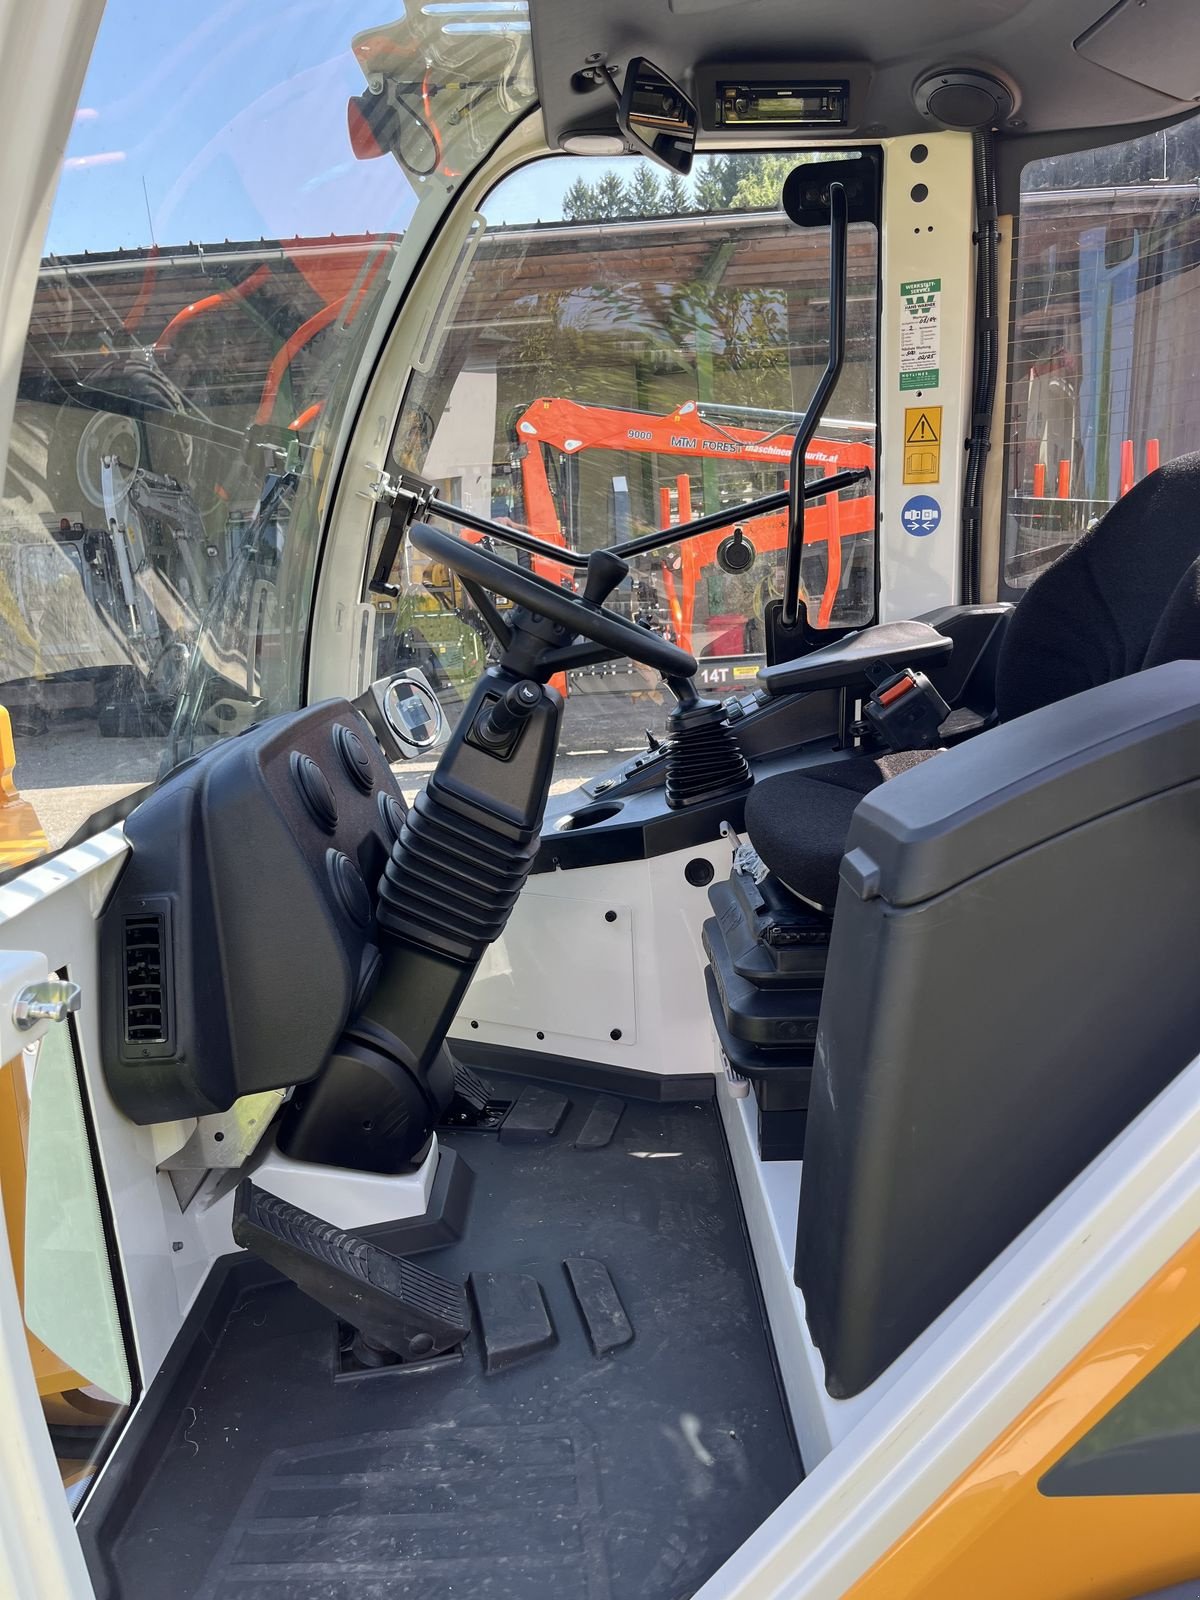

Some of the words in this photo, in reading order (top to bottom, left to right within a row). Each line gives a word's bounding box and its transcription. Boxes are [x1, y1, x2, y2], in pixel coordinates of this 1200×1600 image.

[628, 429, 653, 441] 9000
[671, 436, 697, 449] MTM
[702, 440, 742, 453] FOREST
[700, 668, 729, 683] 14T
